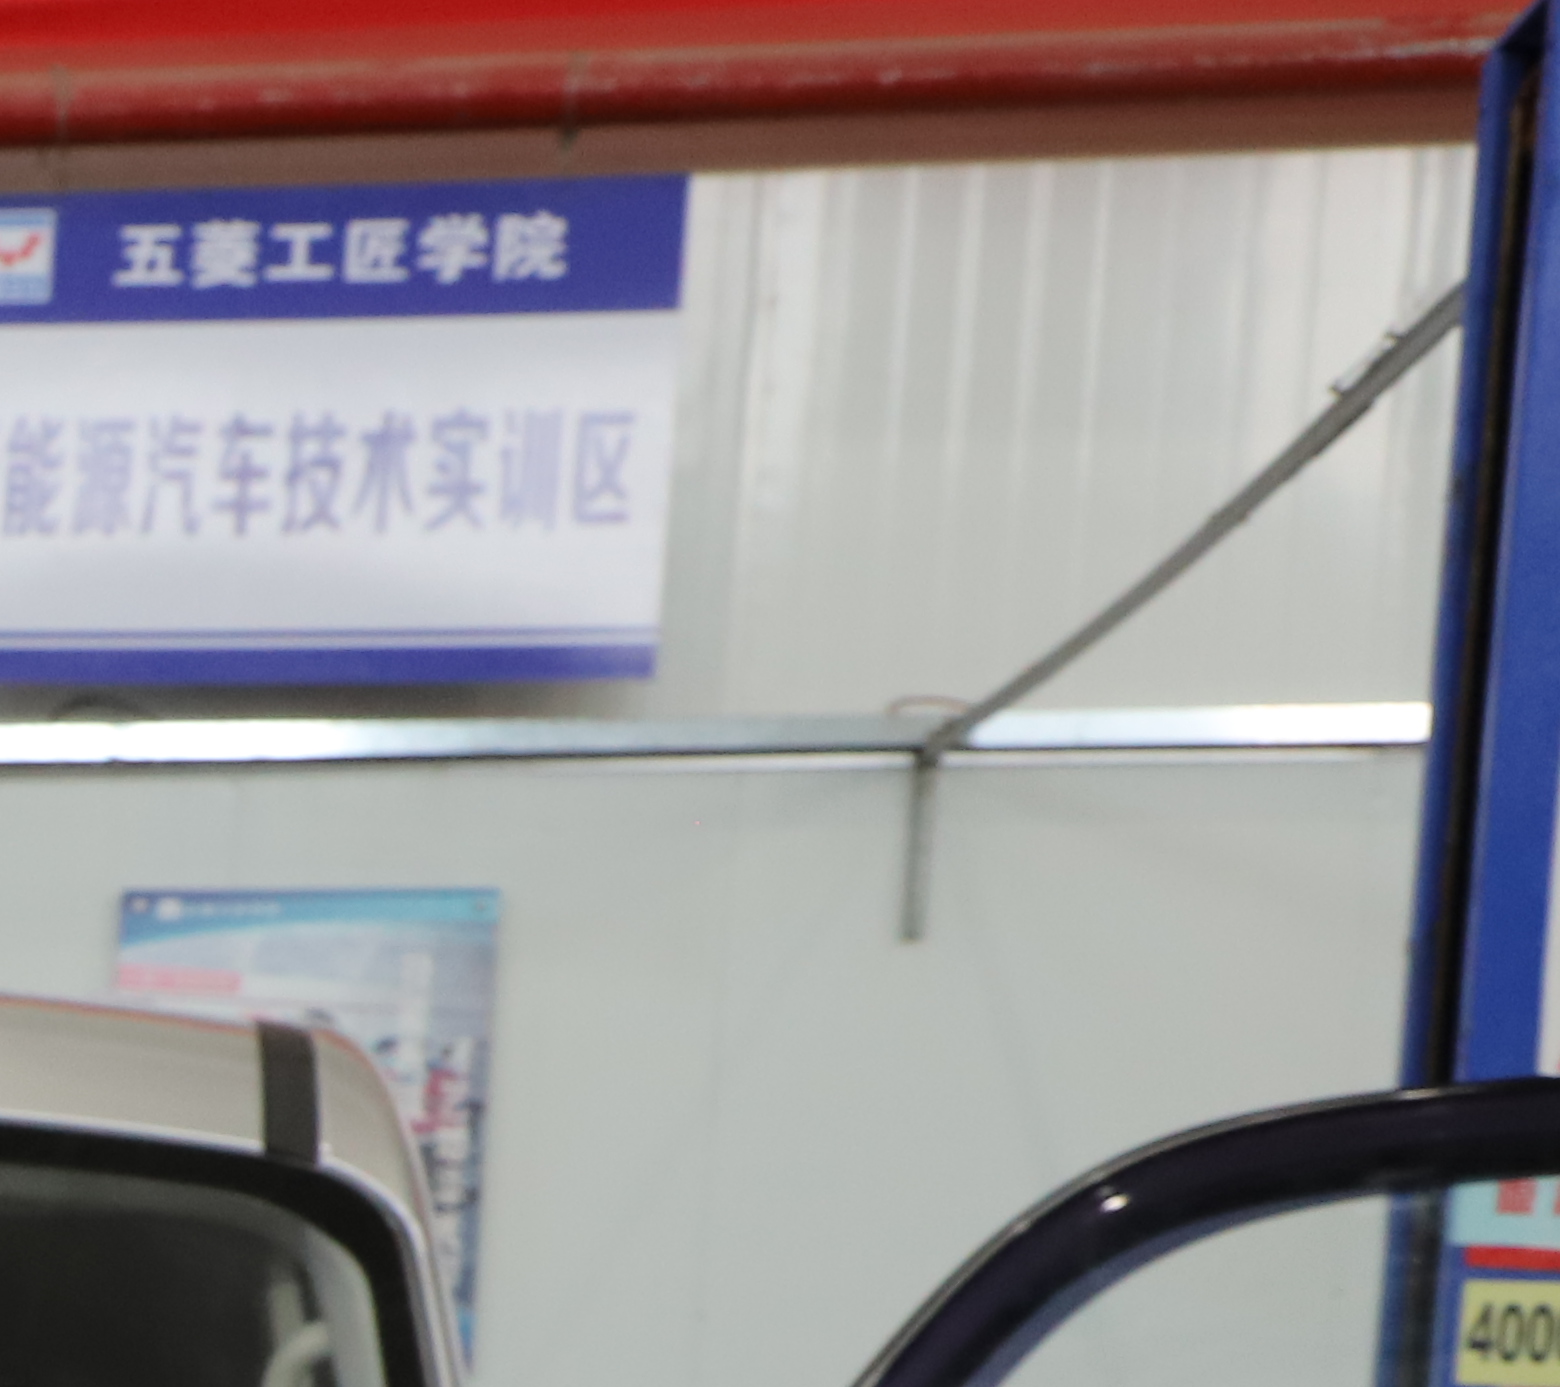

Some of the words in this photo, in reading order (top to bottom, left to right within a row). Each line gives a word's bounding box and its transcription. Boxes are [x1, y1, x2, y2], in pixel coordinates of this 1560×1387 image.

[112, 211, 569, 290] 五菱工匠学院
[1466, 1302, 1560, 1364] 400
